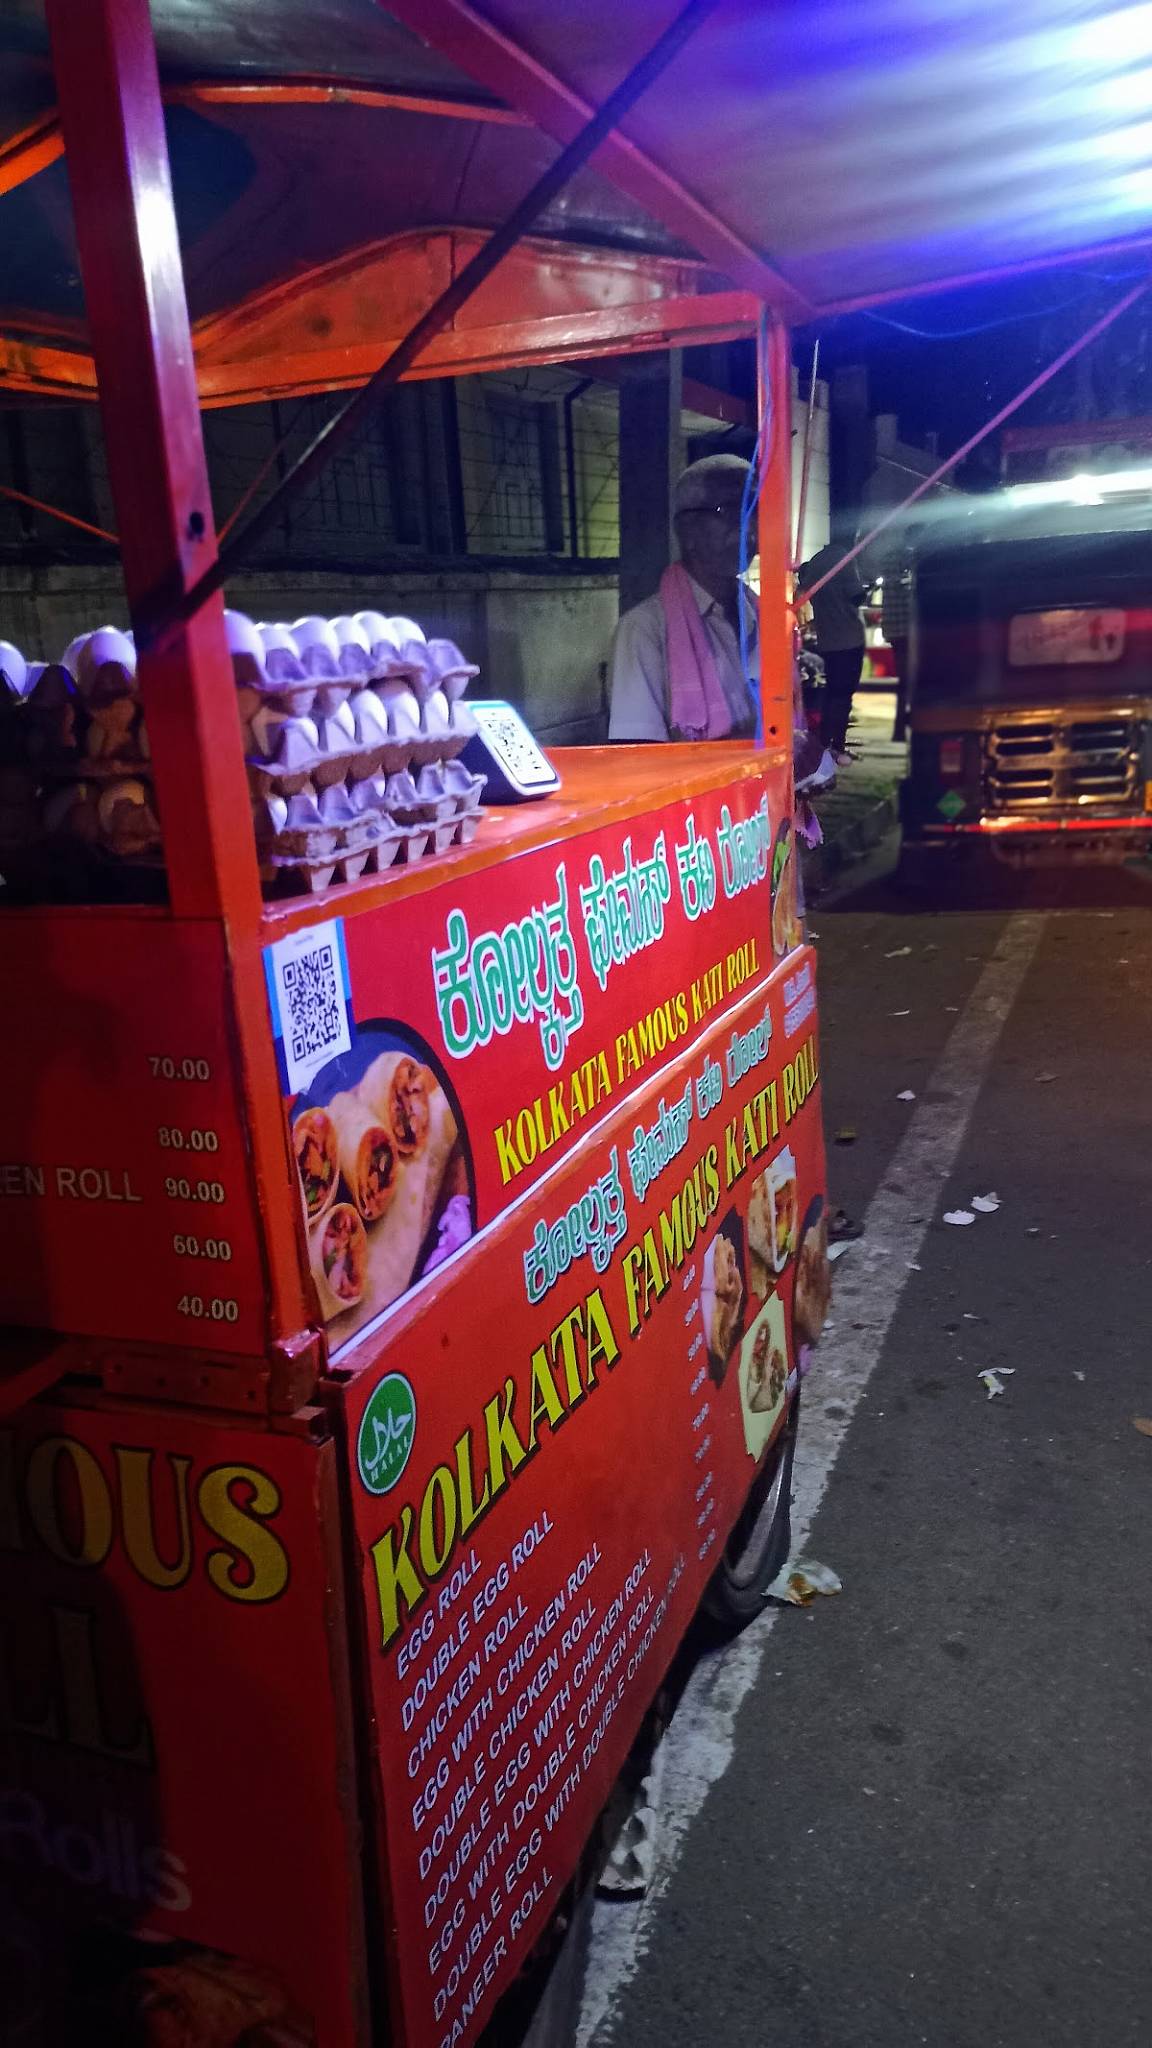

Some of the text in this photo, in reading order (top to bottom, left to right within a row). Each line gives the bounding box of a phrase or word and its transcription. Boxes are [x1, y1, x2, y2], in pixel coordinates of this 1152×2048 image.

[579, 830, 671, 991] ಫೇಮಸ್
[150, 1056, 209, 1080] 70.00
[158, 1127, 218, 1152] 80.00
[494, 1050, 612, 1185] KOLKATA
[615, 992, 689, 1085] FAMOUS
[691, 962, 724, 1024] KATI
[727, 938, 759, 992] ROLL
[628, 1077, 692, 1202] ಫೇಮಸ್
[0, 1165, 144, 1202] EN ROLL
[164, 1177, 225, 1203] 90.00
[173, 1234, 232, 1261] 60.00
[177, 1295, 238, 1322] 40.00
[372, 1289, 620, 1647] KOLKATA
[622, 1145, 719, 1336] FAMOUS
[725, 1080, 780, 1189] KATI
[782, 1035, 818, 1123] ROLL
[397, 1550, 481, 1680] EGG ROLL
[402, 1511, 553, 1731] DOUBLE EGG ROLL
[408, 1595, 528, 1777] CHICKEN ROLL
[413, 1543, 601, 1831] EGG WITH CHICKEN ROLL
[419, 1598, 596, 1880] DOUBLE CHICKEN ROLL
[425, 1548, 651, 1928] DOUBLE EGG WITH CHICKEN ROLL
[429, 1586, 654, 1974] EGG WITH DOUBLE CHICKEN ROLL
[434, 1887, 502, 2021] DOUBLE
[505, 1828, 542, 1893] EGG
[545, 1763, 580, 1832] WITH
[583, 1675, 624, 1770] DOUBLE
[510, 1867, 552, 1940] ROLL
